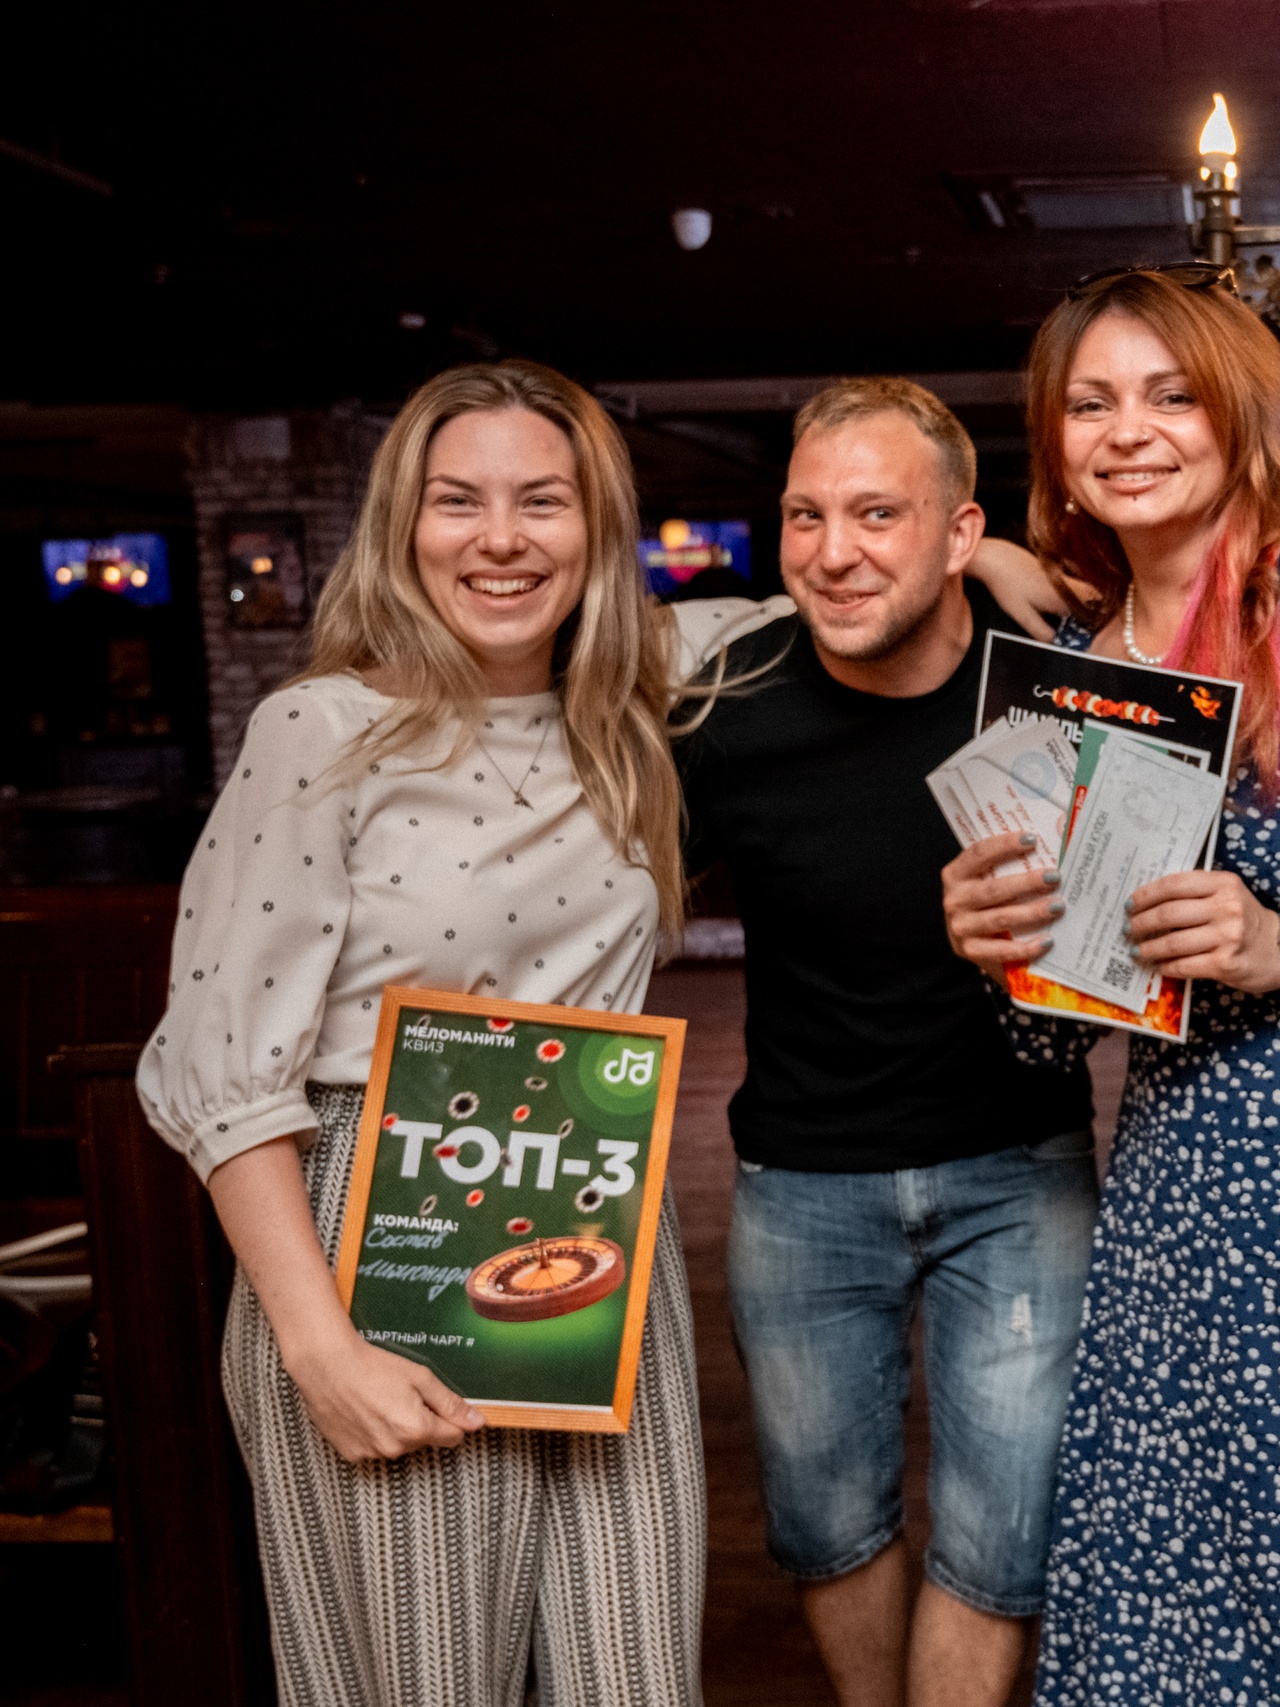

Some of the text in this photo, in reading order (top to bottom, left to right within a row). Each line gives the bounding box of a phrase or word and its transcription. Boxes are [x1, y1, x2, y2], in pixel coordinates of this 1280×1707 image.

[404, 1025, 516, 1048] МЕЛОМАНИТИ
[403, 1039, 445, 1054] КВИЗ
[390, 1120, 640, 1197] ТОП-3
[373, 1214, 459, 1232] КОМАНДА:
[430, 1334, 463, 1346] ЧАРТ
